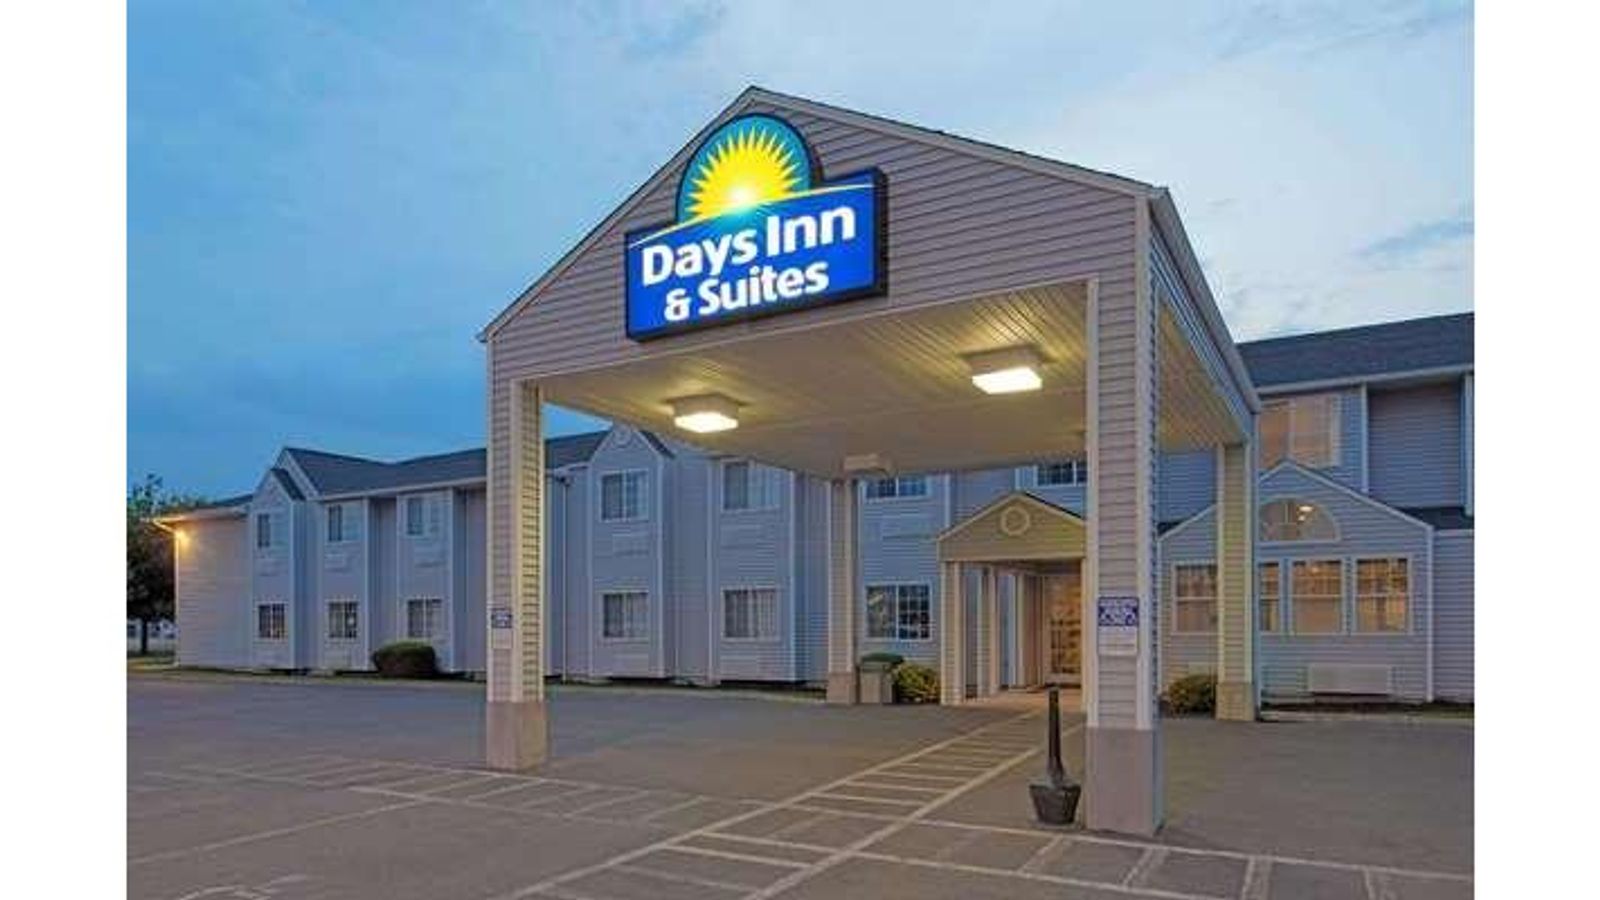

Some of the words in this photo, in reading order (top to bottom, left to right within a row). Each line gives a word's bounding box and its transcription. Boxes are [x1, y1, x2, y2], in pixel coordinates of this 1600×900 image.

[641, 229, 758, 287] Days
[766, 205, 855, 257] Inn
[664, 288, 692, 322] &
[697, 262, 829, 315] Suites
